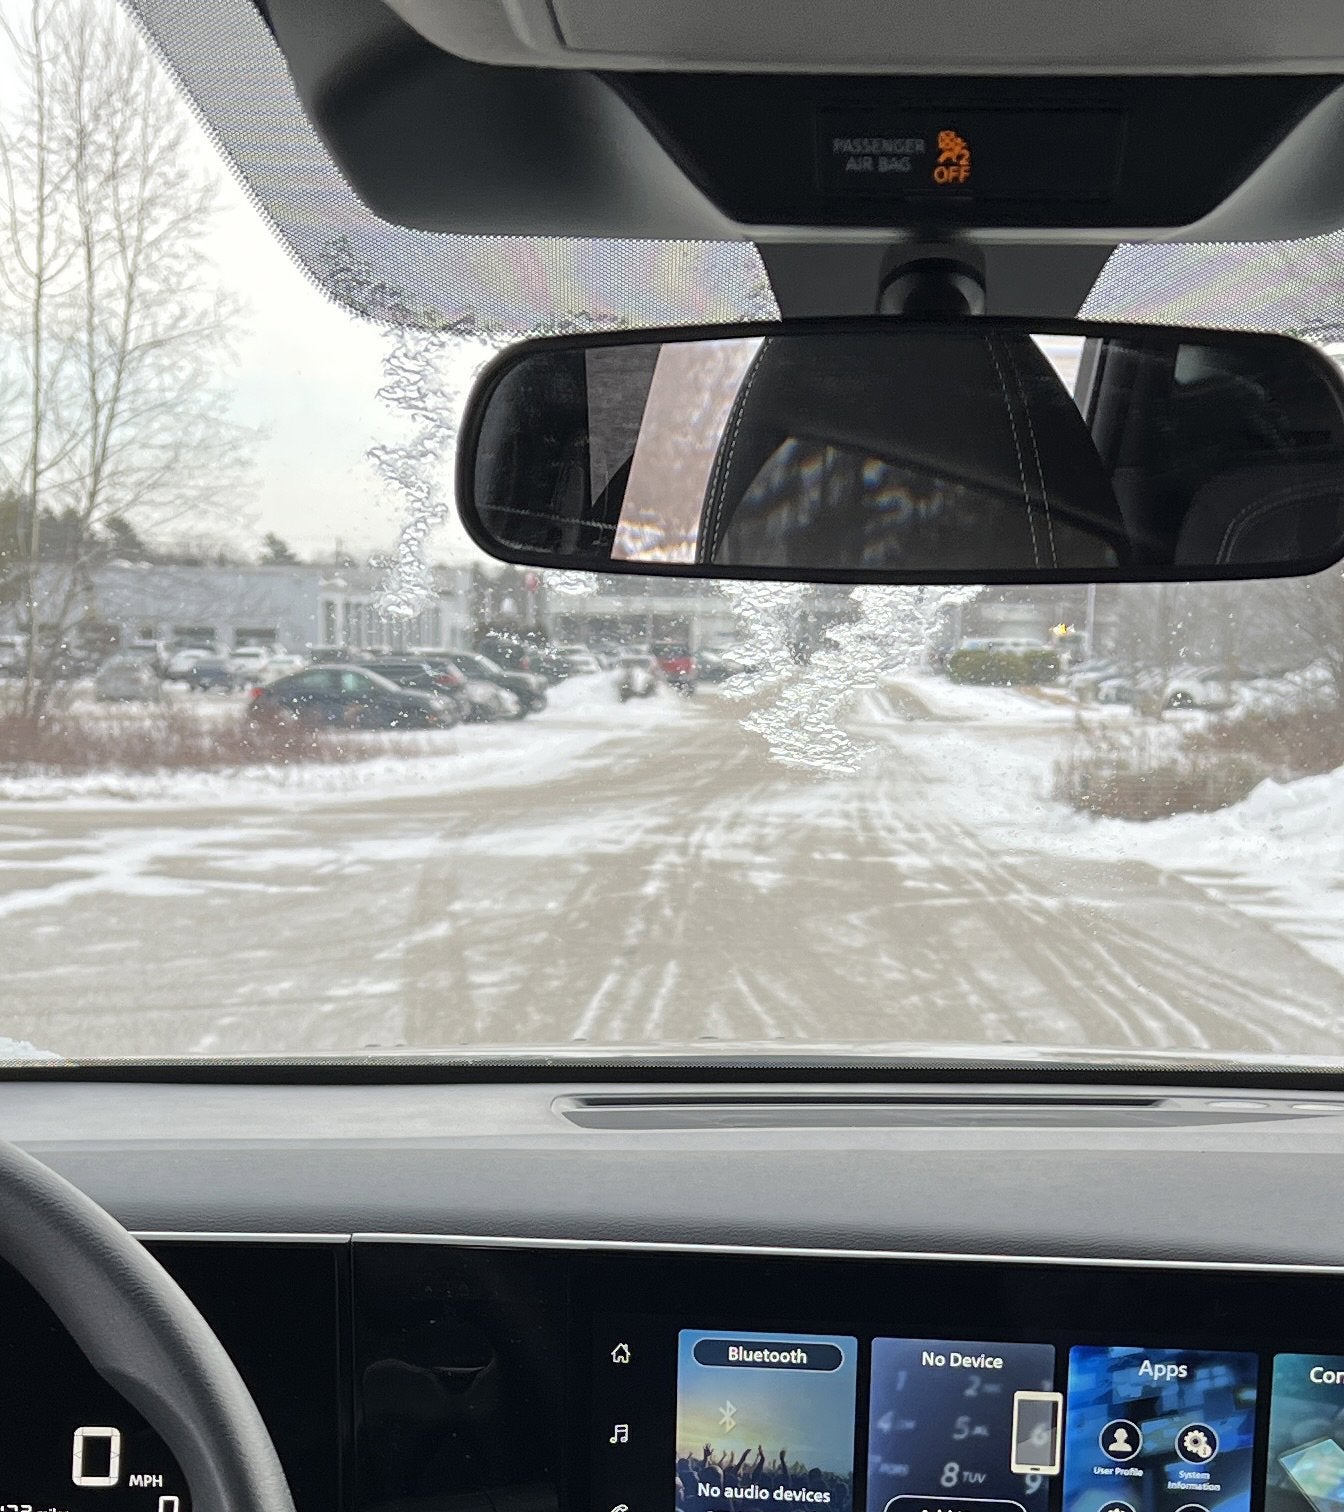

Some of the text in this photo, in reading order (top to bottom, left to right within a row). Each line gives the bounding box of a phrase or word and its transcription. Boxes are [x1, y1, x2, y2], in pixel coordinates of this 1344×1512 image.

[832, 137, 926, 154] PASSENGER
[846, 155, 912, 172] AIR BAG
[933, 165, 971, 184] OFF
[727, 1346, 807, 1365] Bluetooth
[921, 1351, 1004, 1369] No Device
[1138, 1360, 1188, 1381] Apps
[71, 1426, 121, 1487] 0
[940, 1461, 960, 1488] 8
[1093, 1466, 1144, 1477] User Profile
[1178, 1470, 1211, 1480] System
[128, 1474, 163, 1488] MPH
[1167, 1481, 1221, 1492] Information
[697, 1482, 831, 1503] No audio devices
